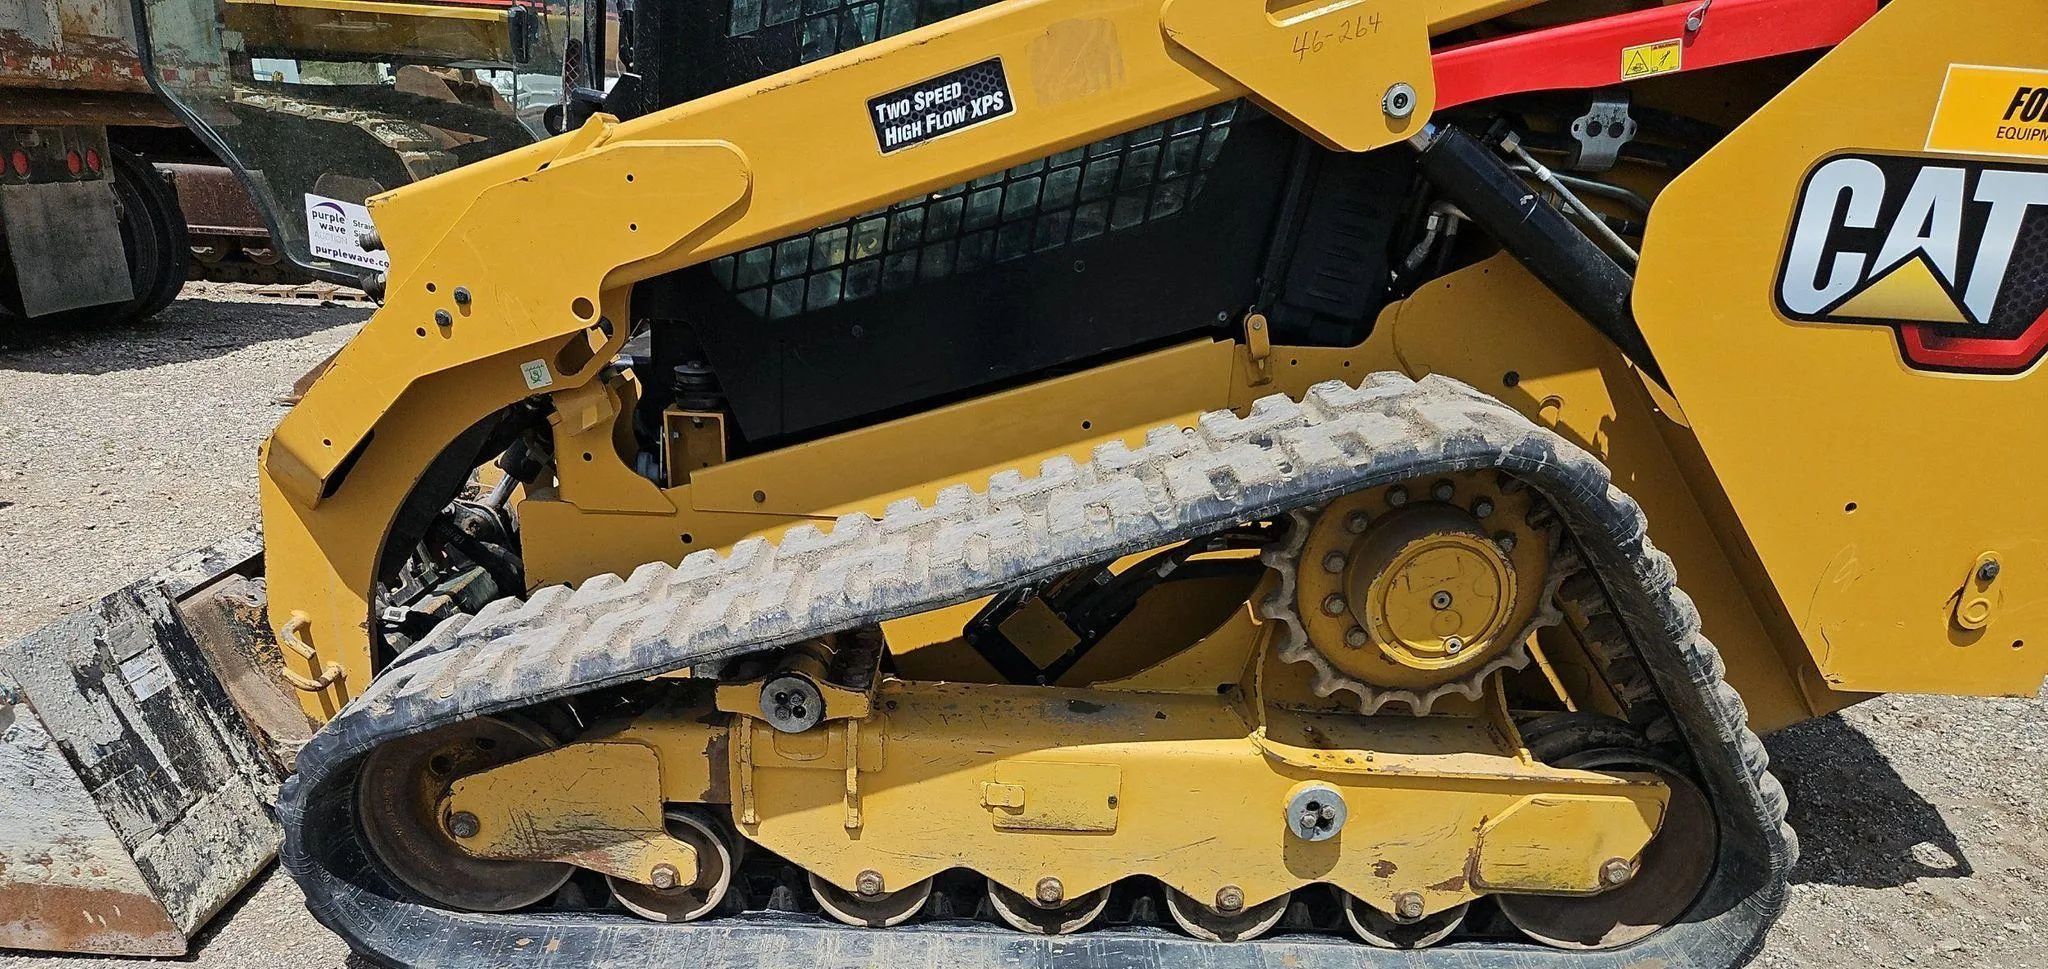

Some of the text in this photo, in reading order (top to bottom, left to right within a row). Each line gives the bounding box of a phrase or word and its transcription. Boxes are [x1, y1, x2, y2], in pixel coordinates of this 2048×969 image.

[1292, 12, 1383, 64] 46-264
[876, 82, 961, 124] TWO SPEED
[885, 91, 1004, 147] HIGH FLOW XPS
[312, 210, 346, 224] purple
[319, 222, 346, 235] wave
[353, 220, 375, 231] Straig
[315, 245, 390, 268] purplewave.co
[1782, 158, 2048, 325] CAT
